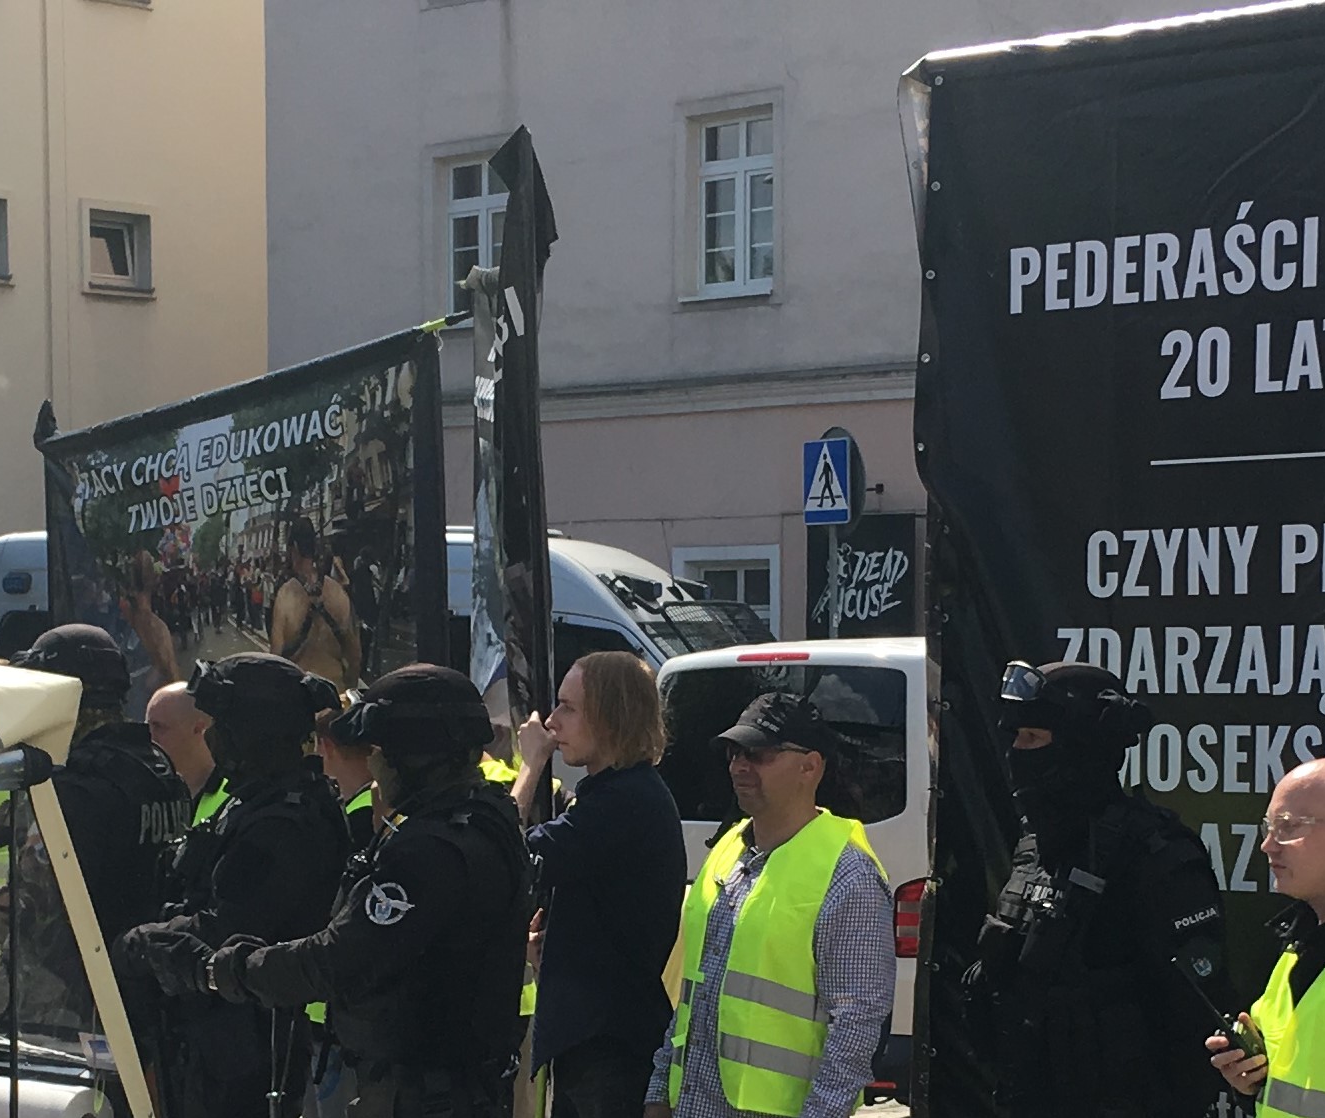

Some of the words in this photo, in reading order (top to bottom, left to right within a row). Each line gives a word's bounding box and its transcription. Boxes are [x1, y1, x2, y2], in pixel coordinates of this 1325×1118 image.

[1009, 201, 1319, 315] PEDERAŚCI
[1160, 326, 1231, 400] 20
[80, 461, 127, 500] TACY
[131, 443, 192, 485] CHCĄ
[196, 394, 343, 471] EDUKOWAĆ
[127, 487, 198, 534] TWOJE
[201, 467, 292, 516] DZIECI
[1086, 524, 1262, 599] CZYNY
[1174, 907, 1218, 930] POLICJA
